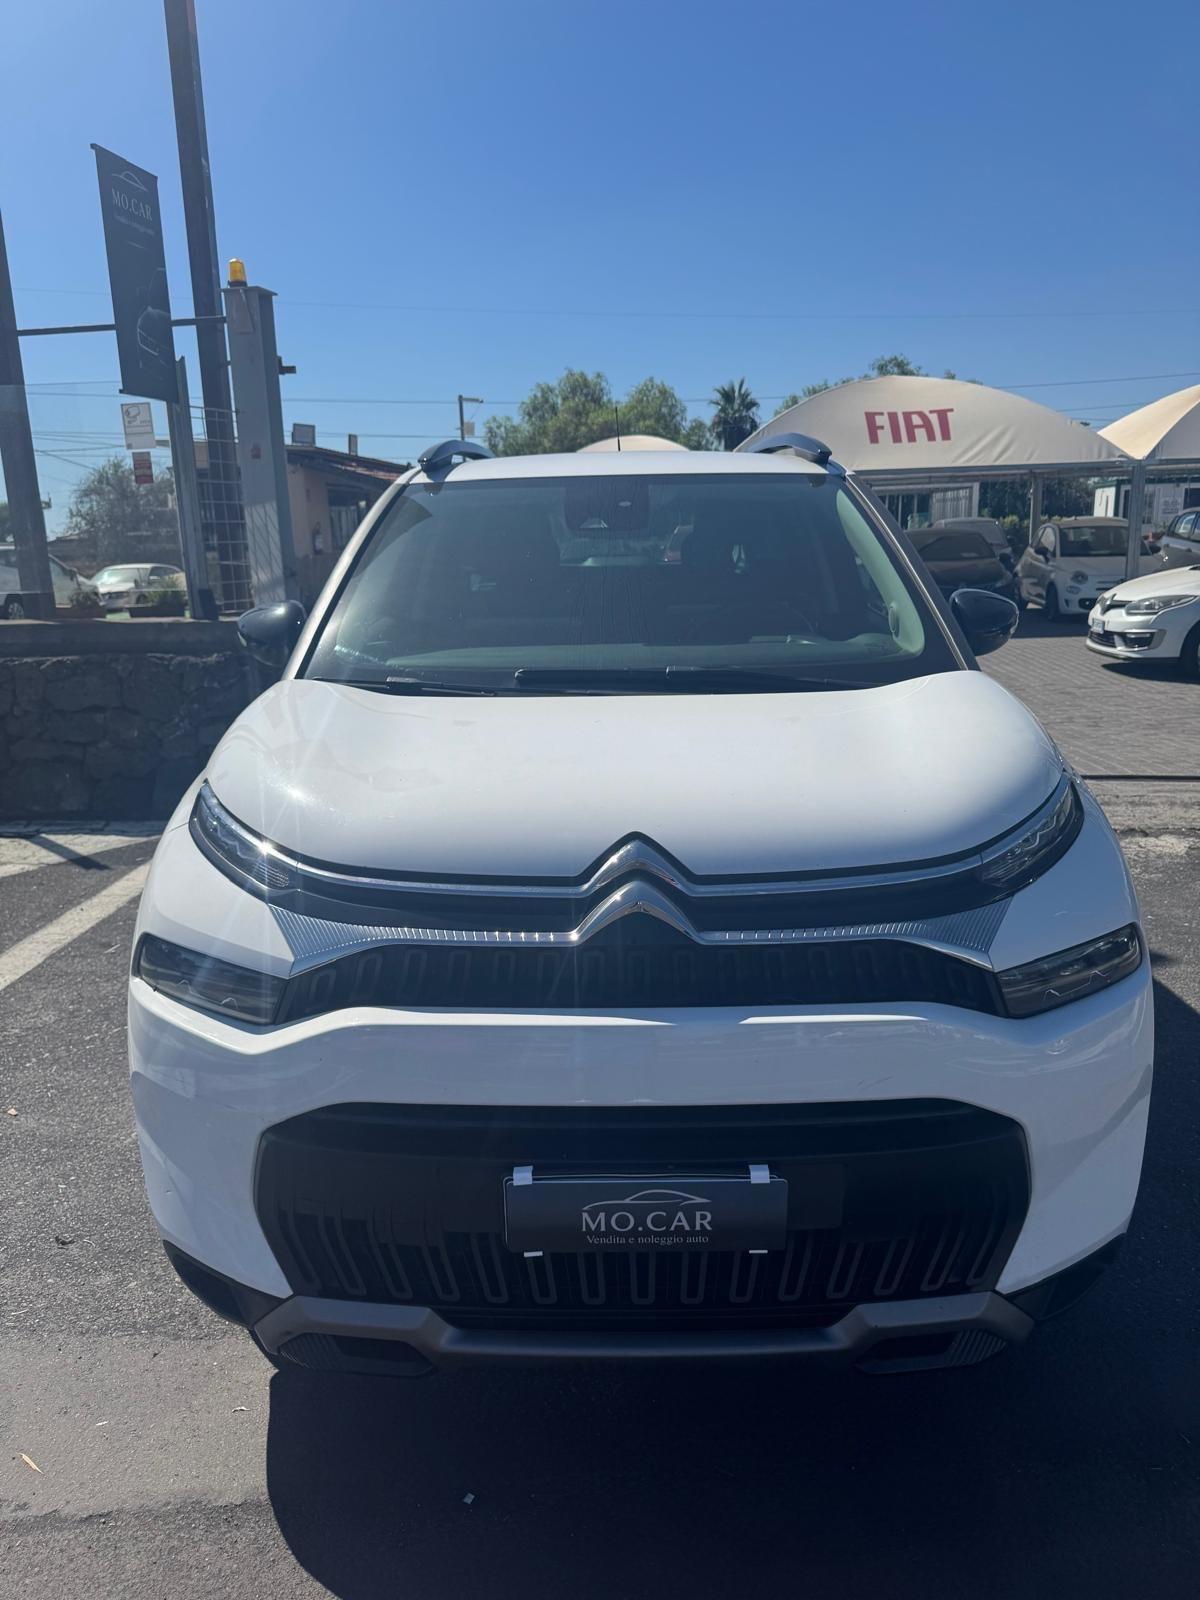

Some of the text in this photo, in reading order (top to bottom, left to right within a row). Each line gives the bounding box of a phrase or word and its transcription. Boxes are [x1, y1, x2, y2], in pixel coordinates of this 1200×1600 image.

[112, 188, 153, 221] MO.CAR
[864, 408, 954, 444] FIAT
[581, 1210, 713, 1232] MO.CAR
[586, 1234, 626, 1244] Vendita
[637, 1234, 684, 1246] noleggio
[686, 1235, 709, 1243] auto
